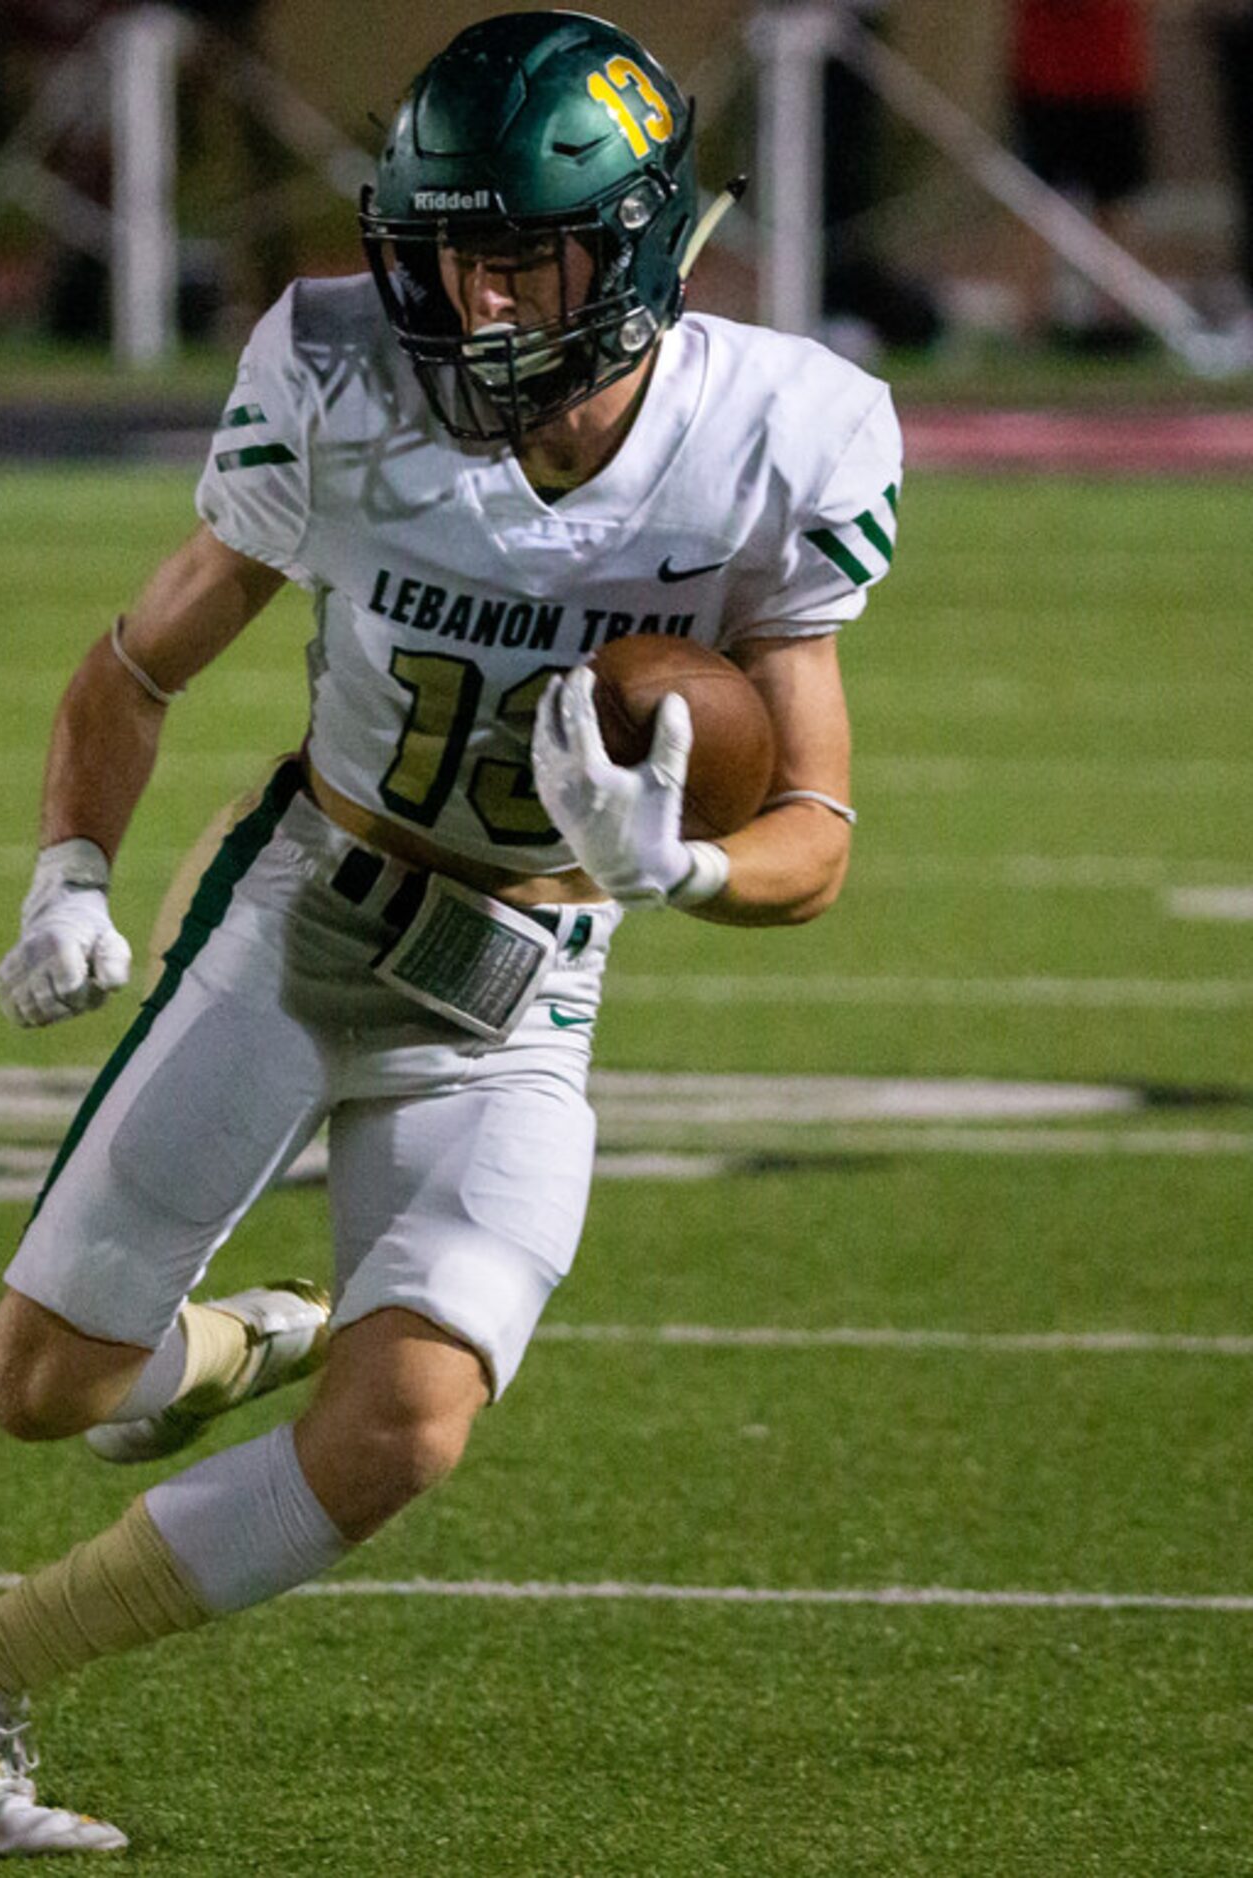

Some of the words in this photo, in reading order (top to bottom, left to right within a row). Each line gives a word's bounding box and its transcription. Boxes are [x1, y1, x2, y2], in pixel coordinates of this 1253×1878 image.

[587, 55, 674, 159] 13
[414, 190, 489, 212] Riddell
[368, 568, 564, 651] LEBANON
